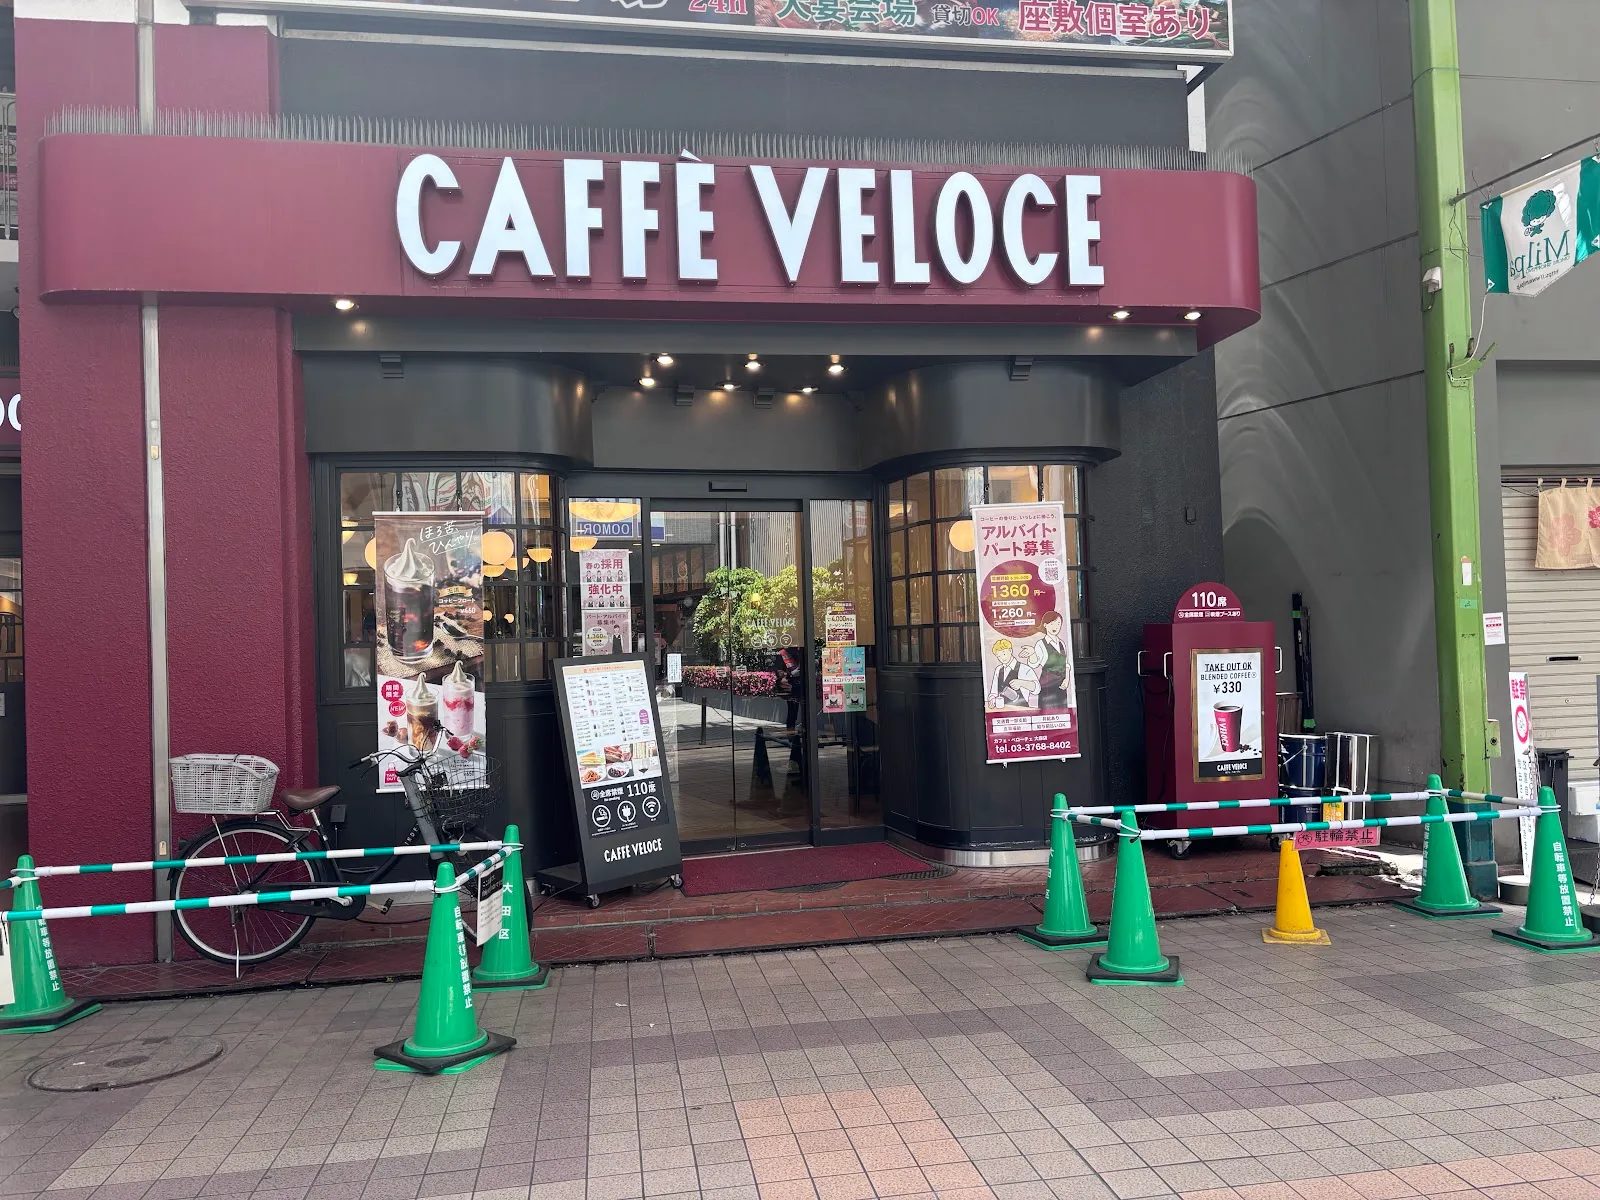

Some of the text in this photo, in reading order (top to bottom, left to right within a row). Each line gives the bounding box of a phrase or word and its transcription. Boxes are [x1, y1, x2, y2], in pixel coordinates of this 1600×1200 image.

[1018, 0, 1211, 39] 座敷個室あり
[397, 149, 1106, 287] CAFFÈ VELOCE
[983, 540, 1056, 557] パート募集
[585, 558, 623, 570] 春の採用
[588, 583, 623, 595] 強化中
[1191, 591, 1227, 608] 110席
[992, 607, 1024, 619] 1,260
[1205, 662, 1252, 672] TAKE OUT OK
[1200, 673, 1228, 681] BLENDED
[1229, 671, 1251, 679] COFFEE
[1213, 681, 1242, 694] ¥330
[390, 704, 406, 712] NEW
[1315, 828, 1374, 843] 駐輪禁止
[631, 838, 663, 857] VELOCE
[1552, 841, 1575, 927] 自転車等放置禁止
